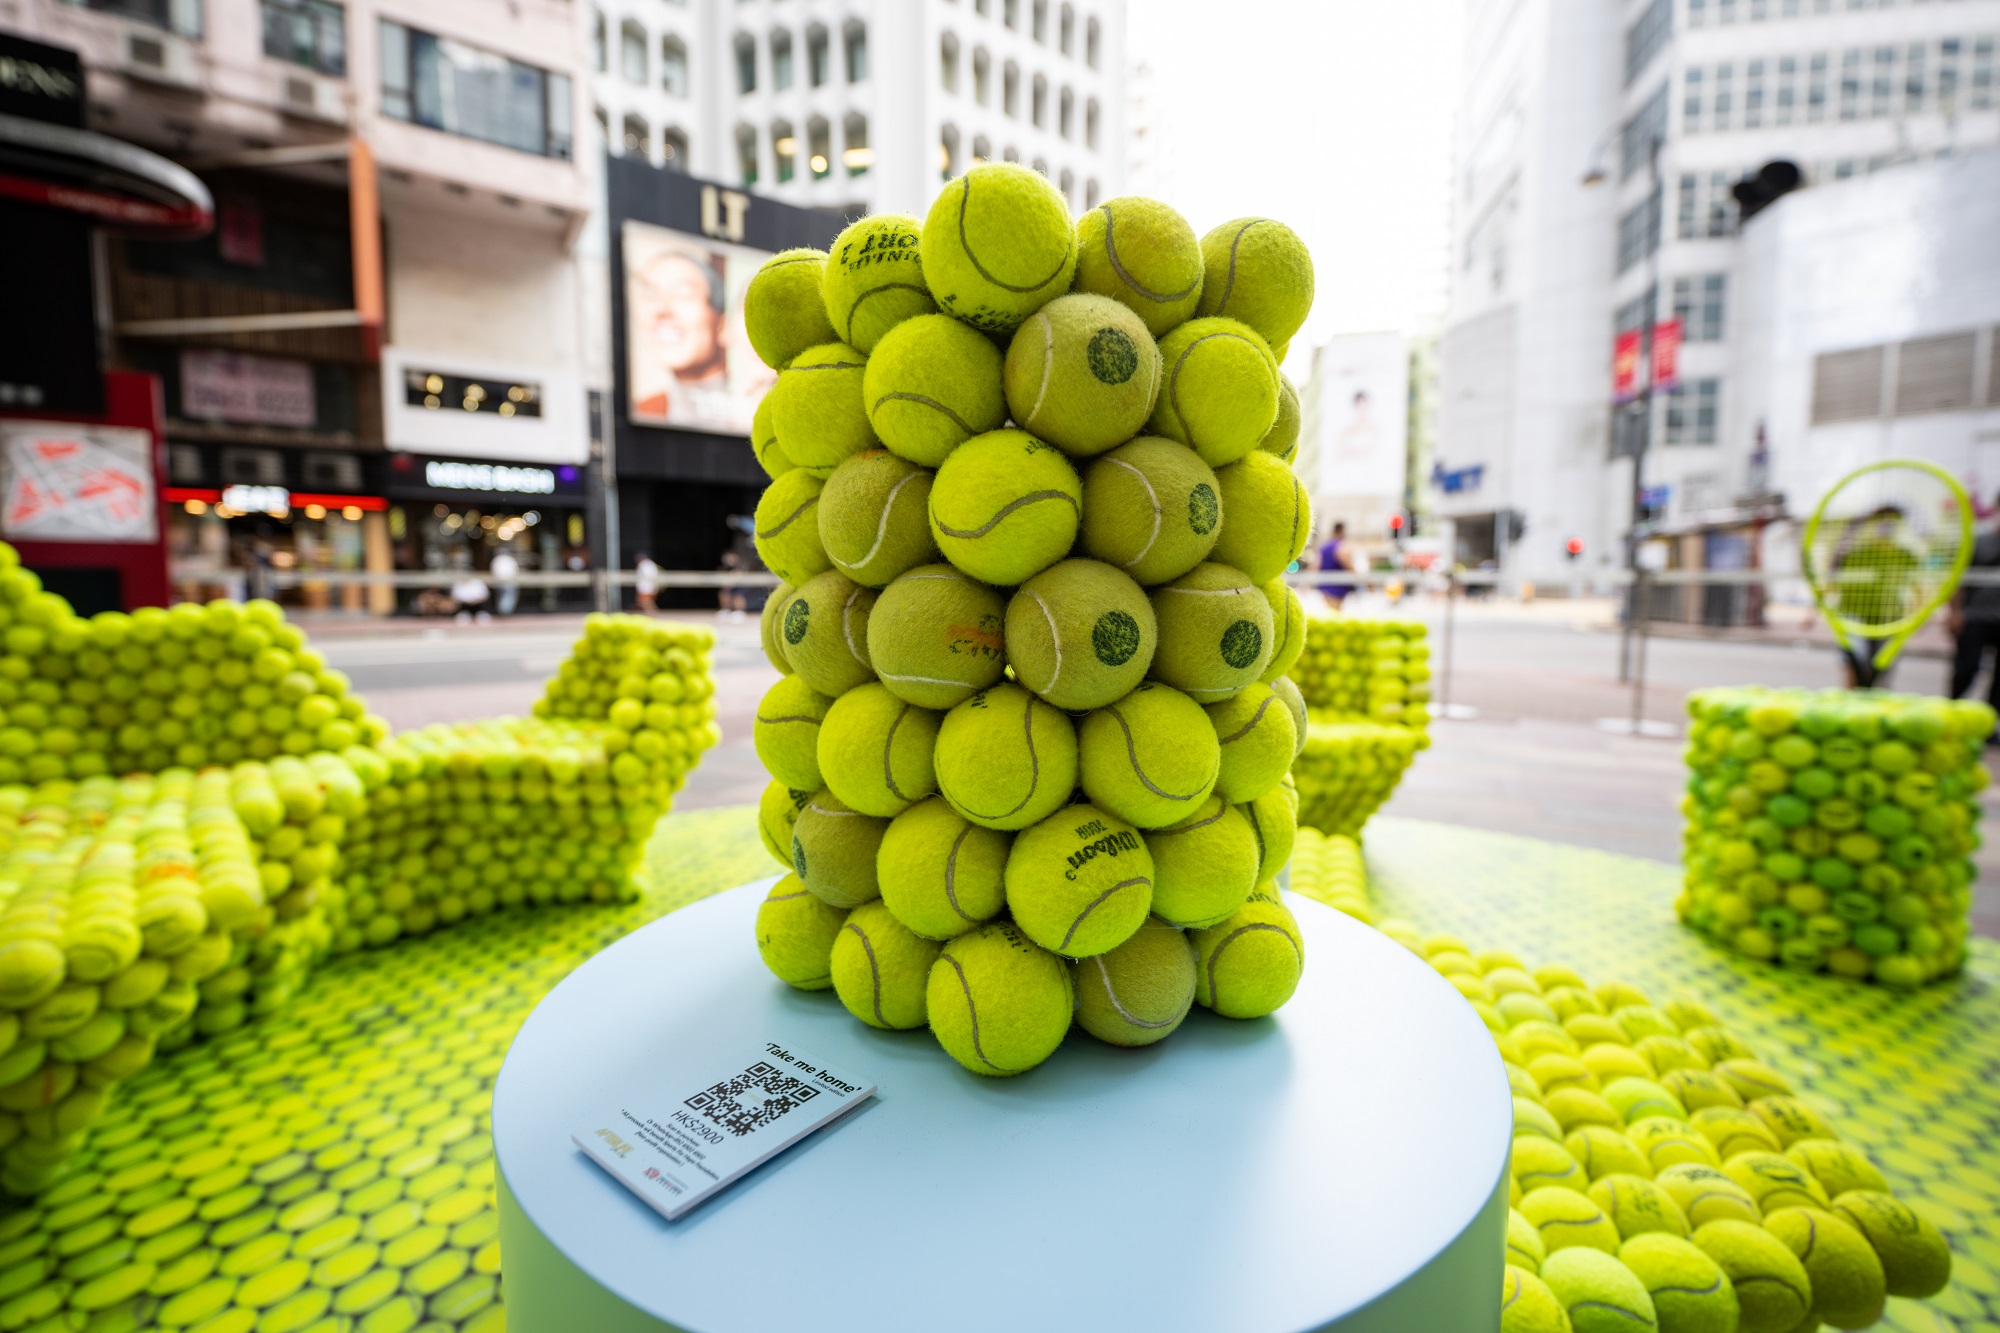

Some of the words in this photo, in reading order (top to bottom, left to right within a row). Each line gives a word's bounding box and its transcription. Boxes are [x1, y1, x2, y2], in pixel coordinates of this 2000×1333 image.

[1066, 830, 1139, 870] Wilson
[793, 1060, 817, 1074] me
[811, 1079, 830, 1091] Limited
[829, 1086, 845, 1098] edition
[671, 1110, 724, 1145] HK$2900
